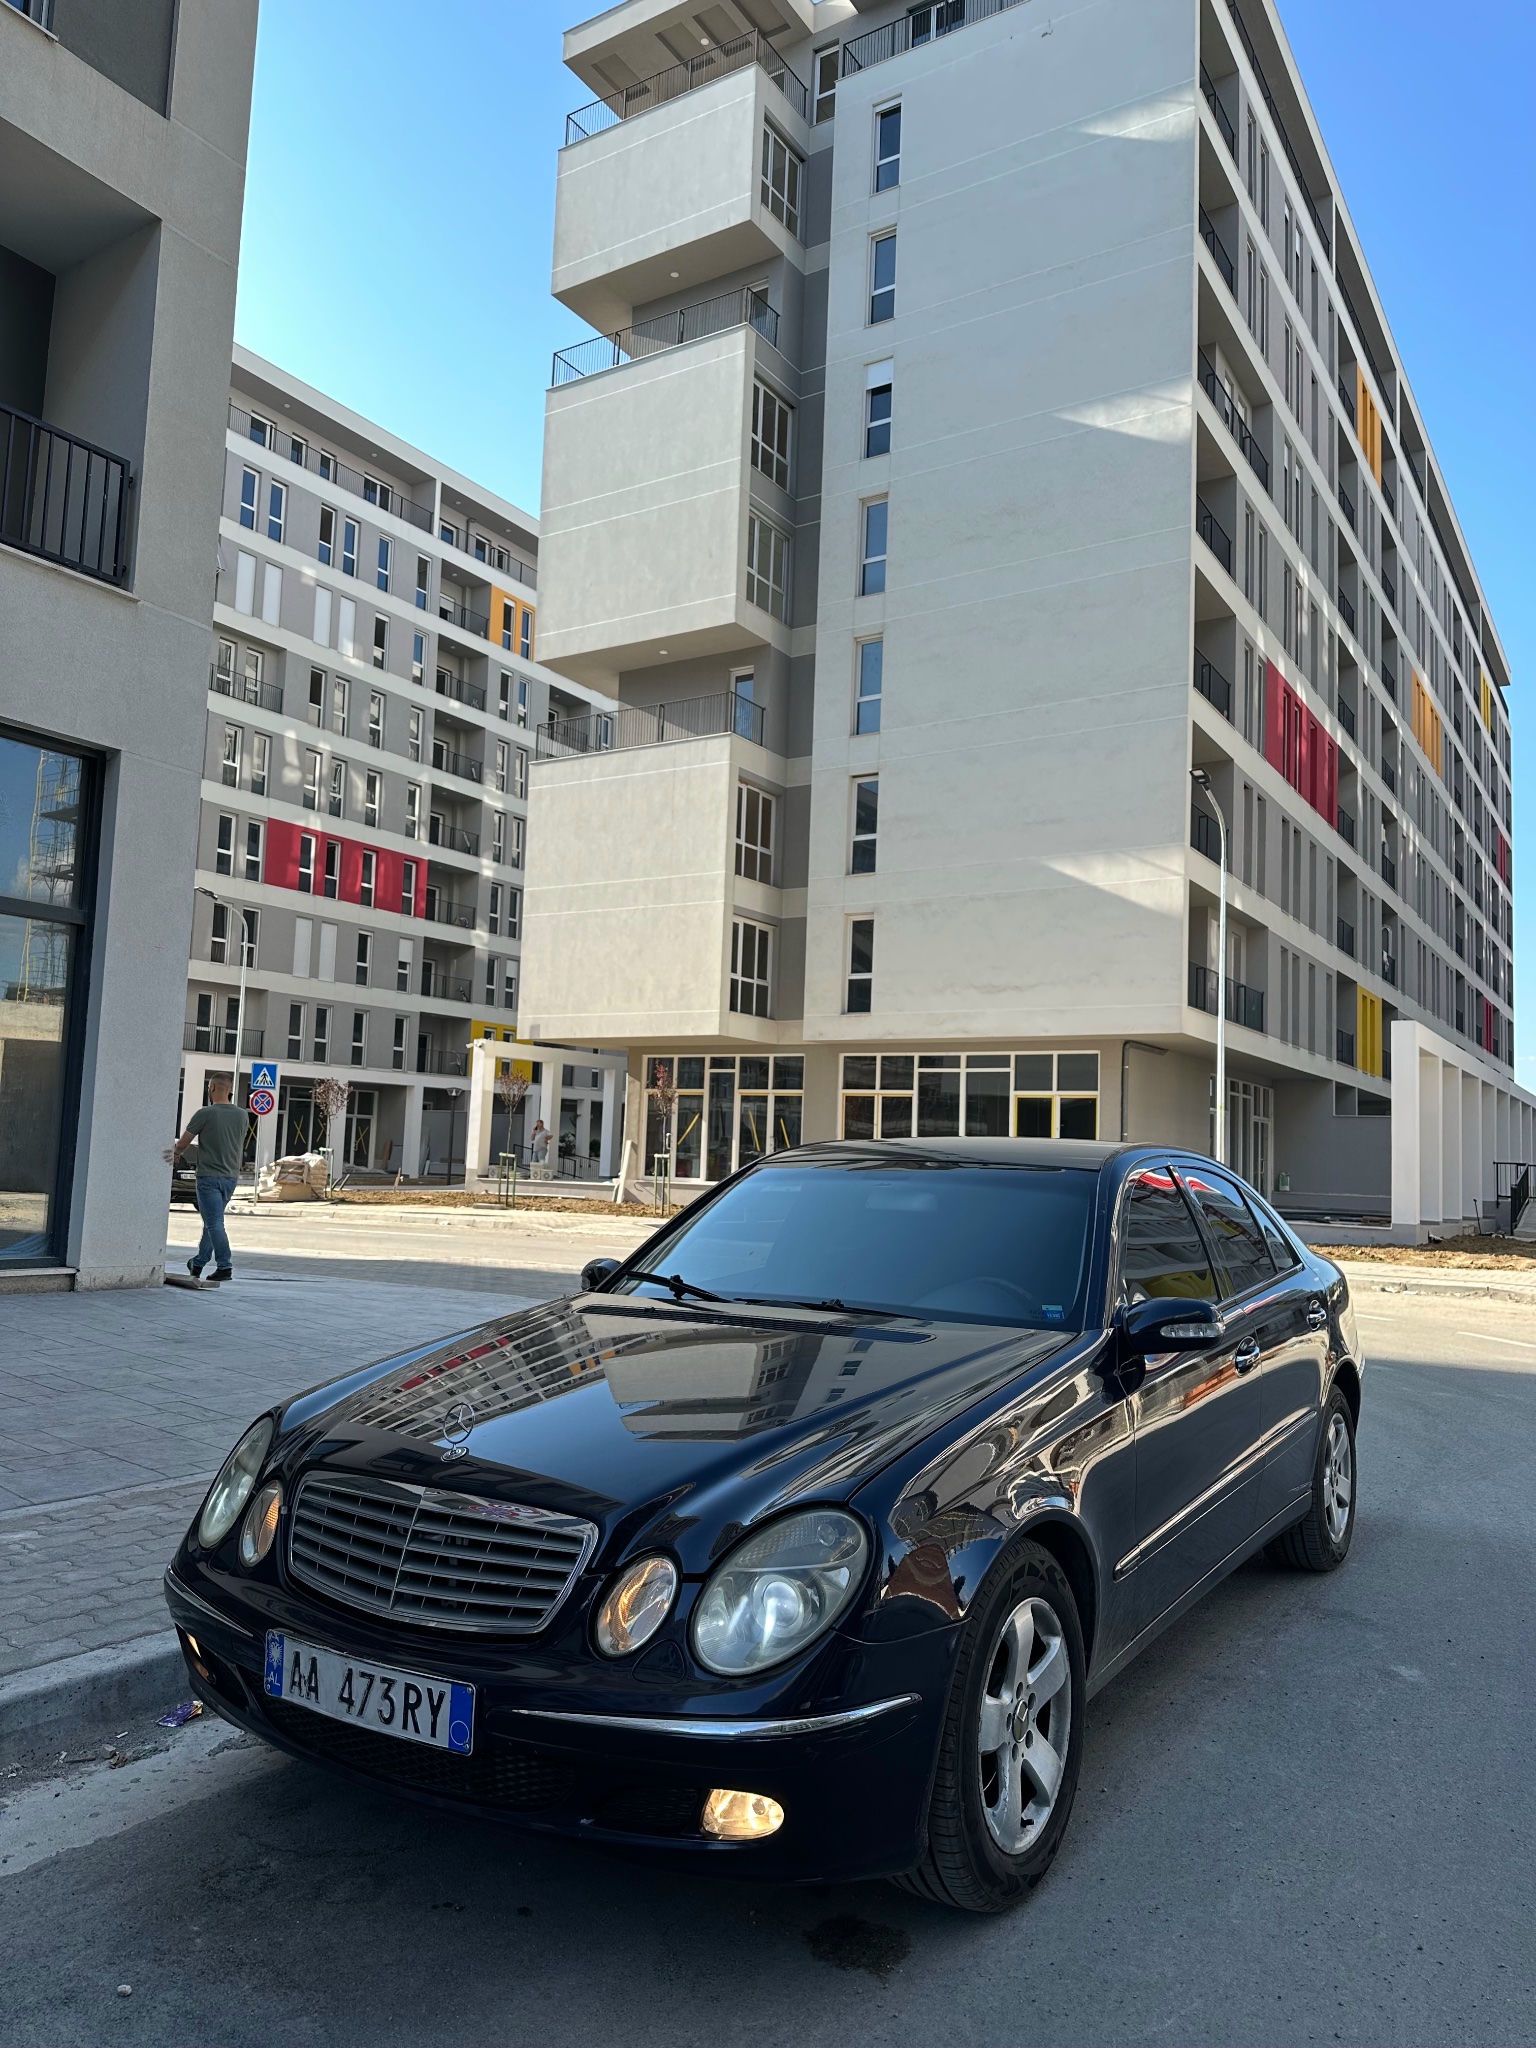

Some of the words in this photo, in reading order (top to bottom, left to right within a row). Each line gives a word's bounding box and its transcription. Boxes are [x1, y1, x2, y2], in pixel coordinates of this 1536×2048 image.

[268, 1671, 280, 1686] AL
[290, 1651, 320, 1704] AA
[338, 1668, 446, 1738] 473RY
